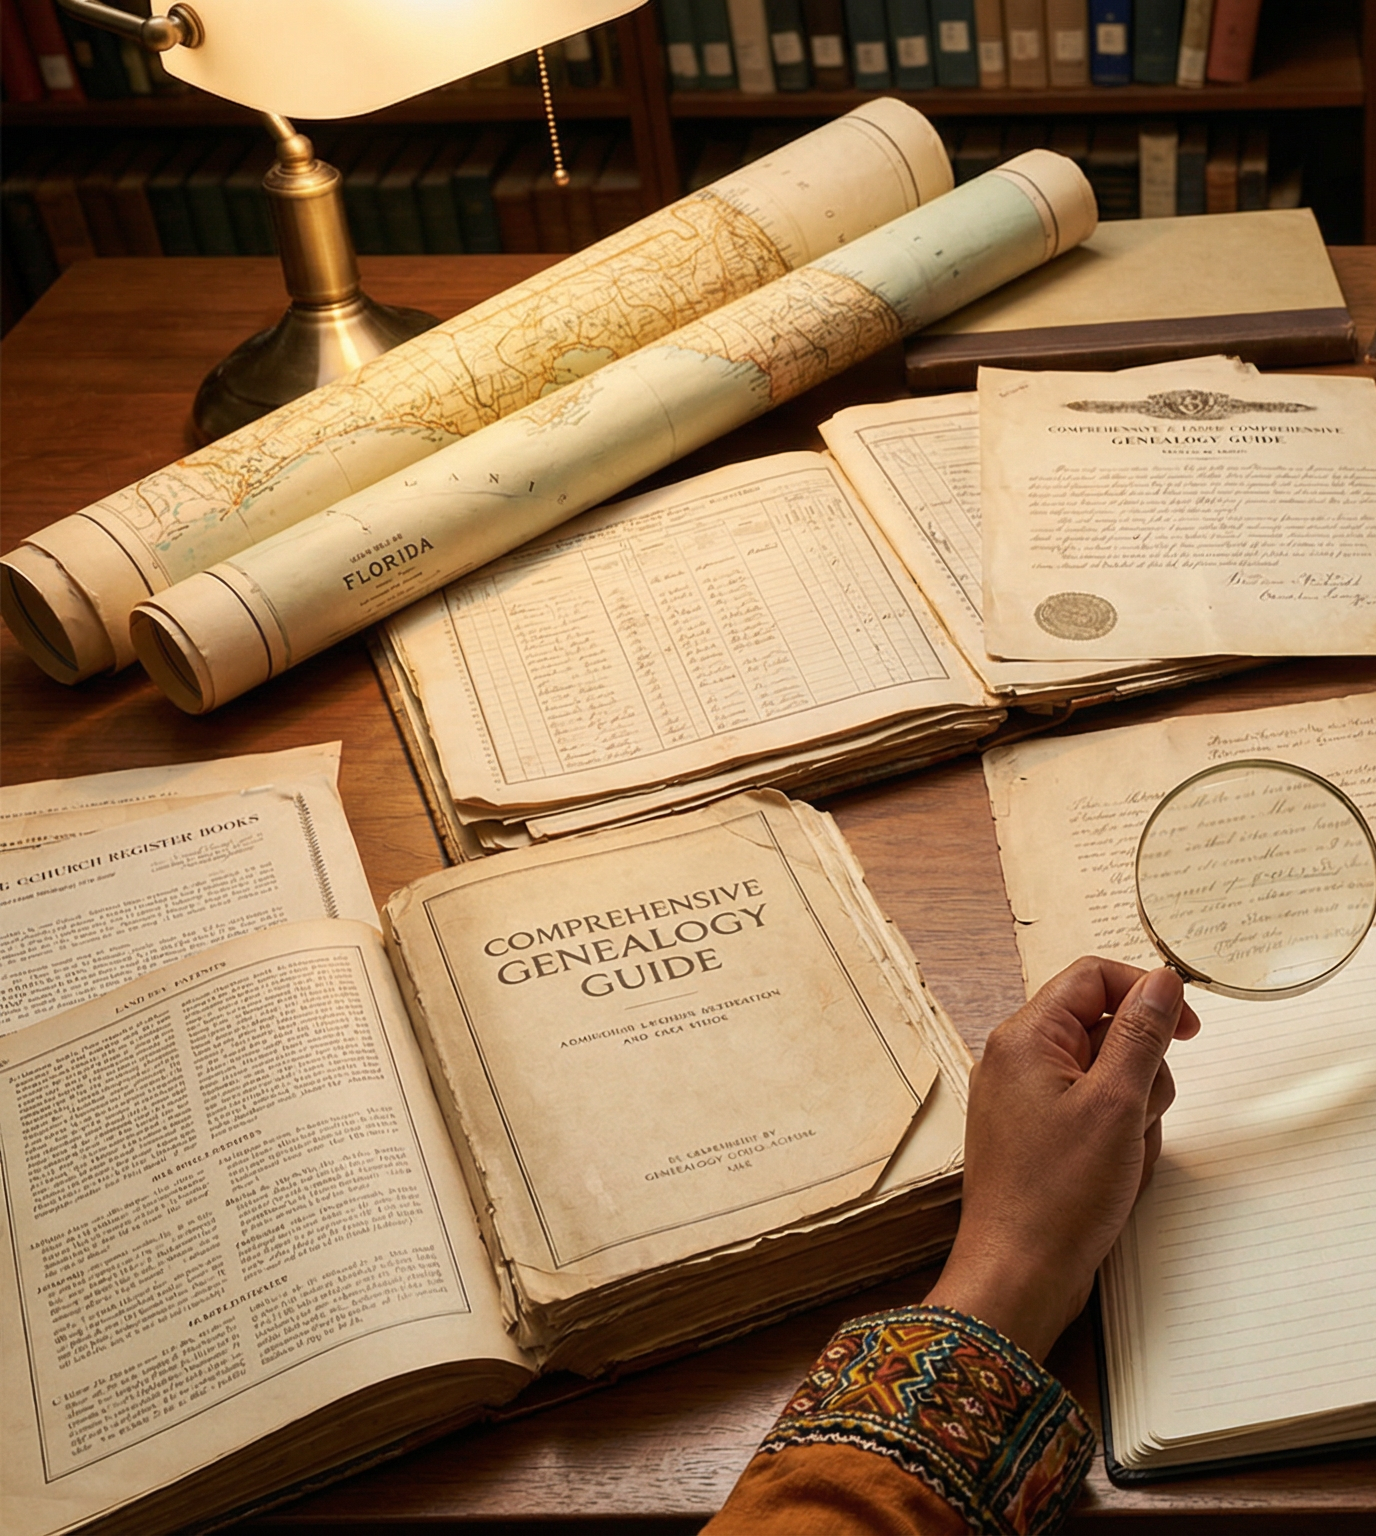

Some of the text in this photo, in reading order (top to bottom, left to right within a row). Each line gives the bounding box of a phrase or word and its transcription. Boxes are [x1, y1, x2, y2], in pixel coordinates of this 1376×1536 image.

[1111, 435, 1286, 446] GENEALOGY GUIDE
[342, 537, 434, 590] FLORIDA
[108, 832, 193, 862] REGISTER
[199, 814, 261, 837] BOOKS
[483, 877, 764, 958] COMPREHENSIVE
[496, 903, 769, 986] GENEALOGY
[580, 948, 723, 998] GUIDE
